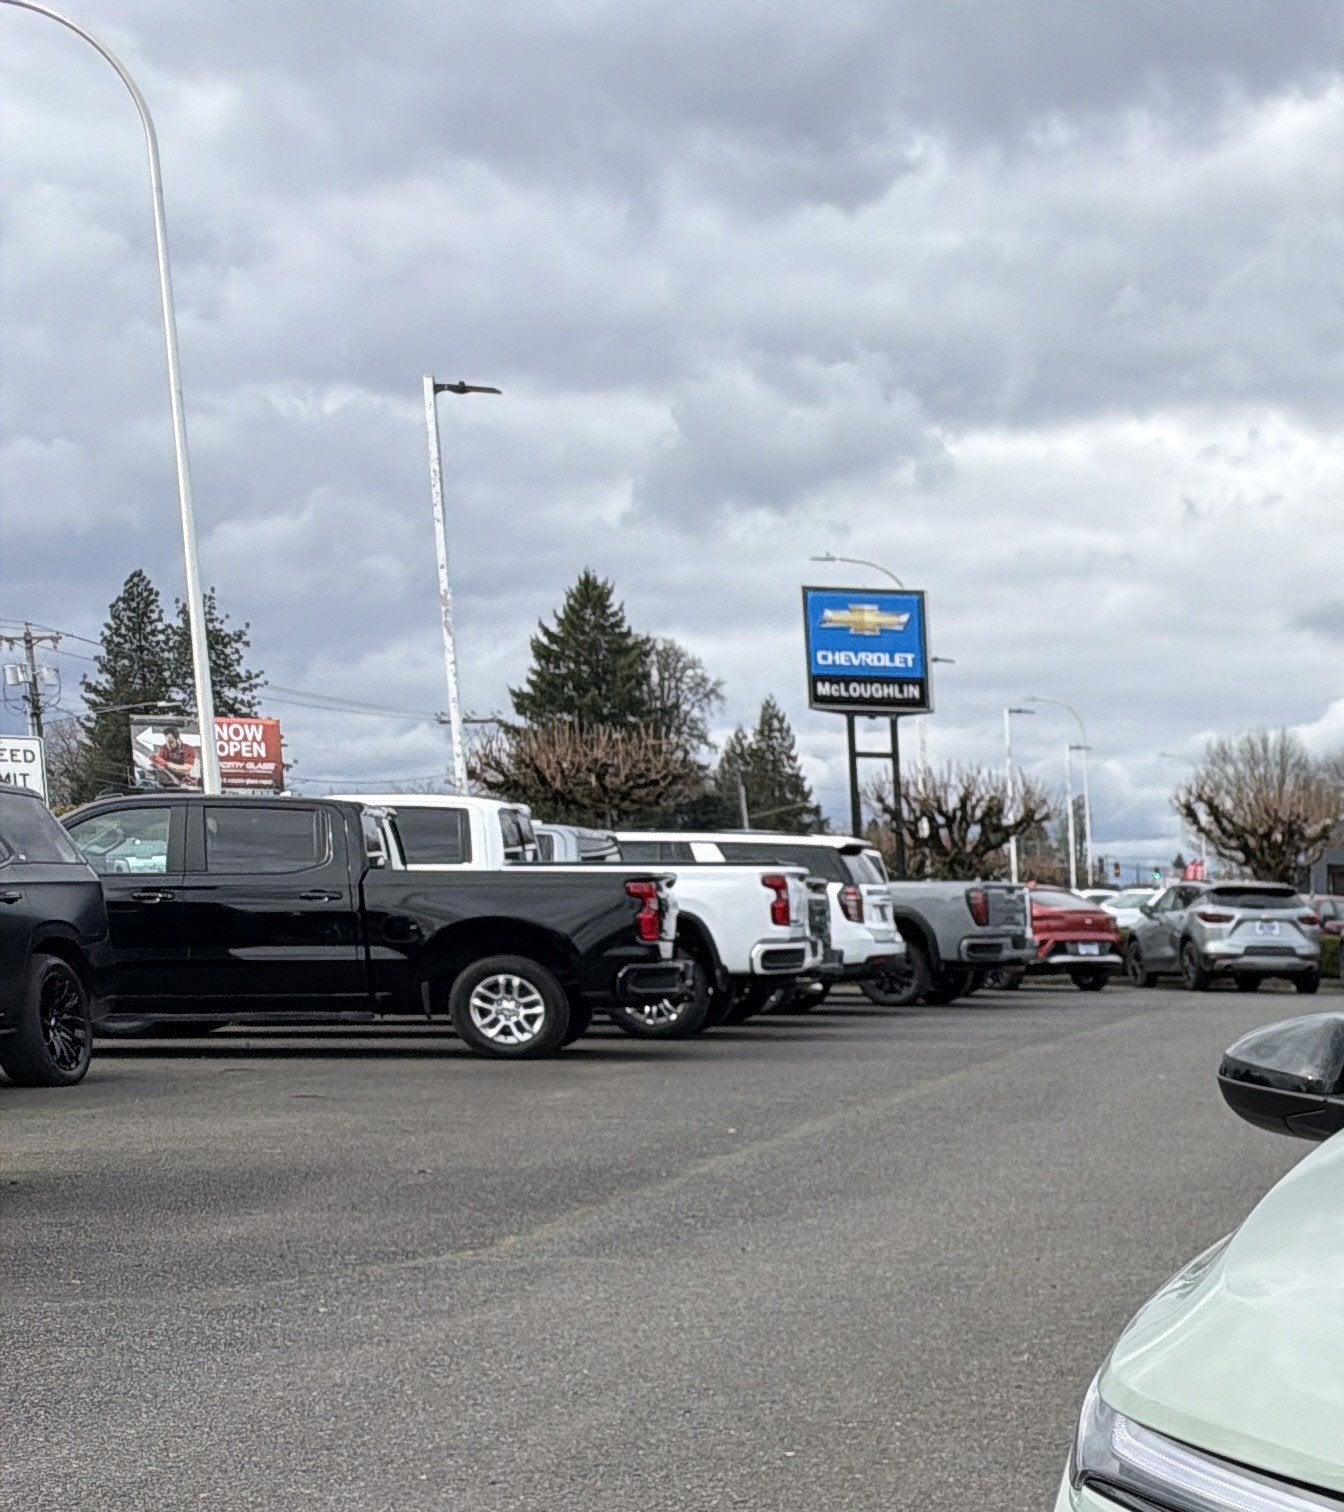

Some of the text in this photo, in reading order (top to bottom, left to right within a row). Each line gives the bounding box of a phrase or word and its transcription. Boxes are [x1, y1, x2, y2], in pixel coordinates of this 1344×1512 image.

[816, 650, 915, 668] CHEVROLET
[816, 681, 920, 699] McLOUGHLIN
[214, 723, 263, 741] NOW
[216, 741, 266, 757] OPEN
